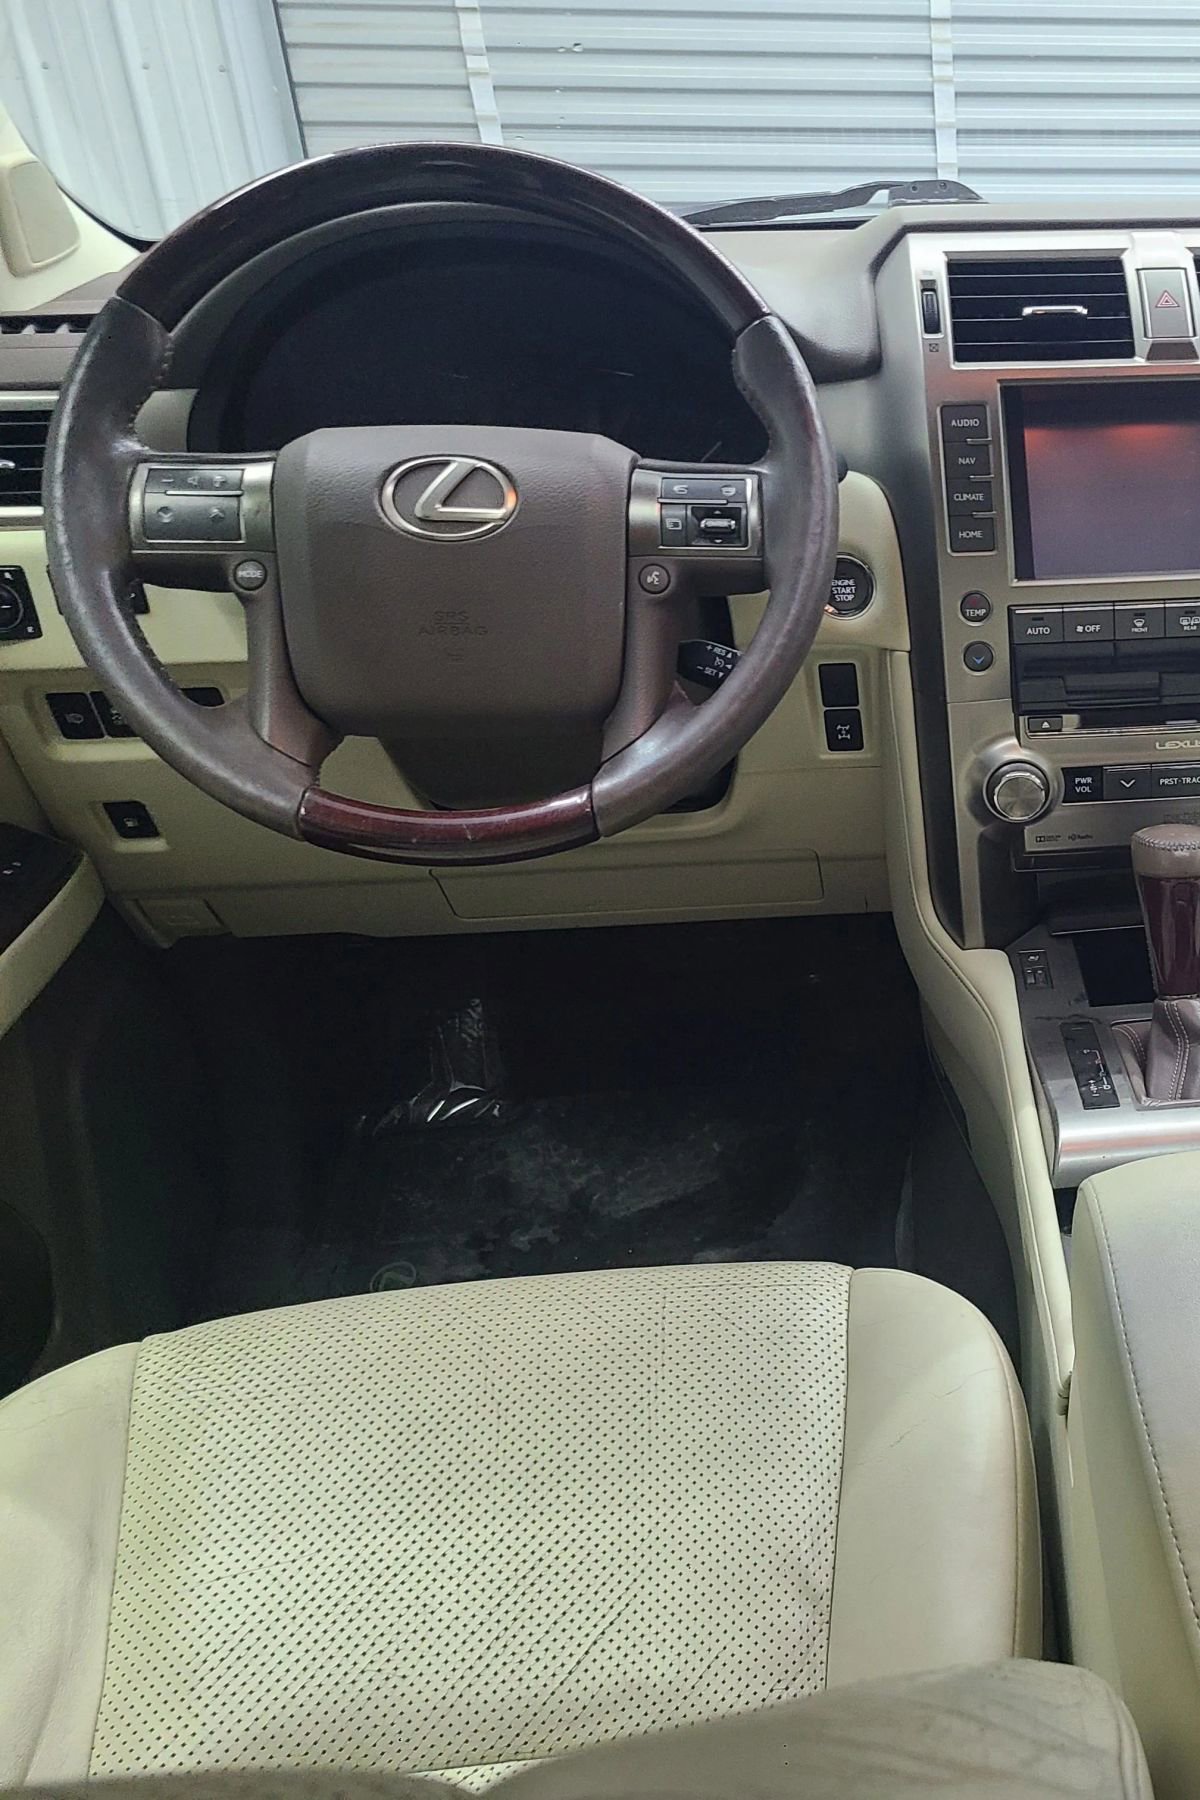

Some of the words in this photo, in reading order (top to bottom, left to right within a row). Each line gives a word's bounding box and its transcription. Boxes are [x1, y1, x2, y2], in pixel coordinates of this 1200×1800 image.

[951, 419, 979, 427] AUDIO
[958, 457, 976, 465] NAV
[953, 493, 984, 501] CLIMATE
[958, 531, 982, 539] HOME
[238, 570, 262, 578] MODE
[966, 609, 986, 617] TEMP
[1027, 628, 1050, 636] AUTO
[1084, 625, 1101, 633] OFF
[1075, 777, 1092, 785] PWR
